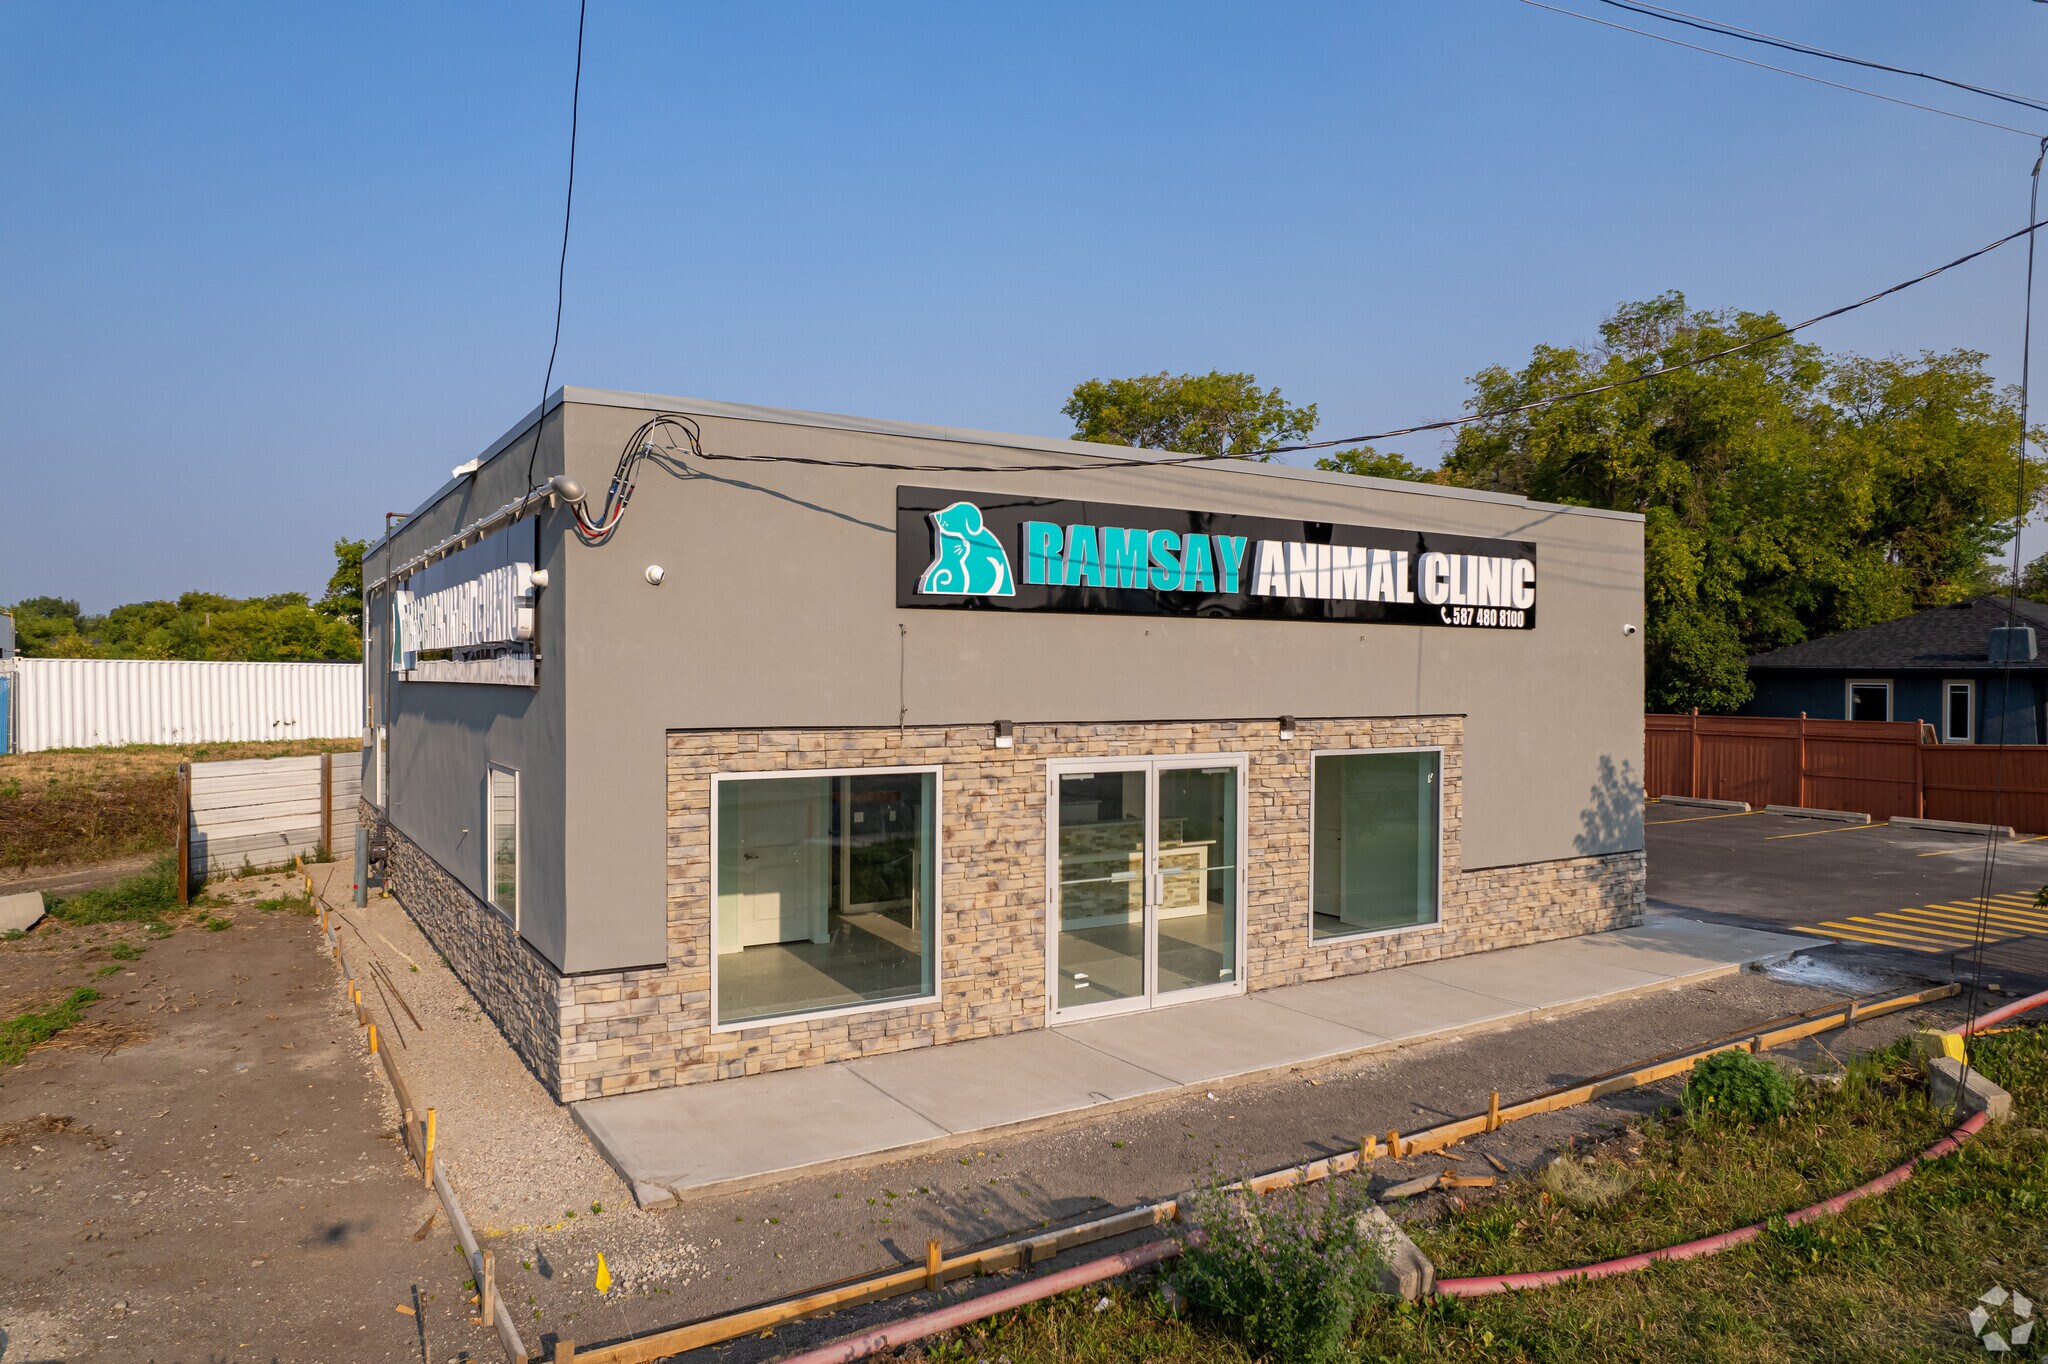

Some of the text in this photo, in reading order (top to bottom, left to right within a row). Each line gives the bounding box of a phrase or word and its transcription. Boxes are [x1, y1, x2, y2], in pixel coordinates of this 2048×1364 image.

[1023, 521, 1535, 609] RAMSAY ANIMAL CLINIC
[1453, 607, 1525, 628] 587 480 8100
